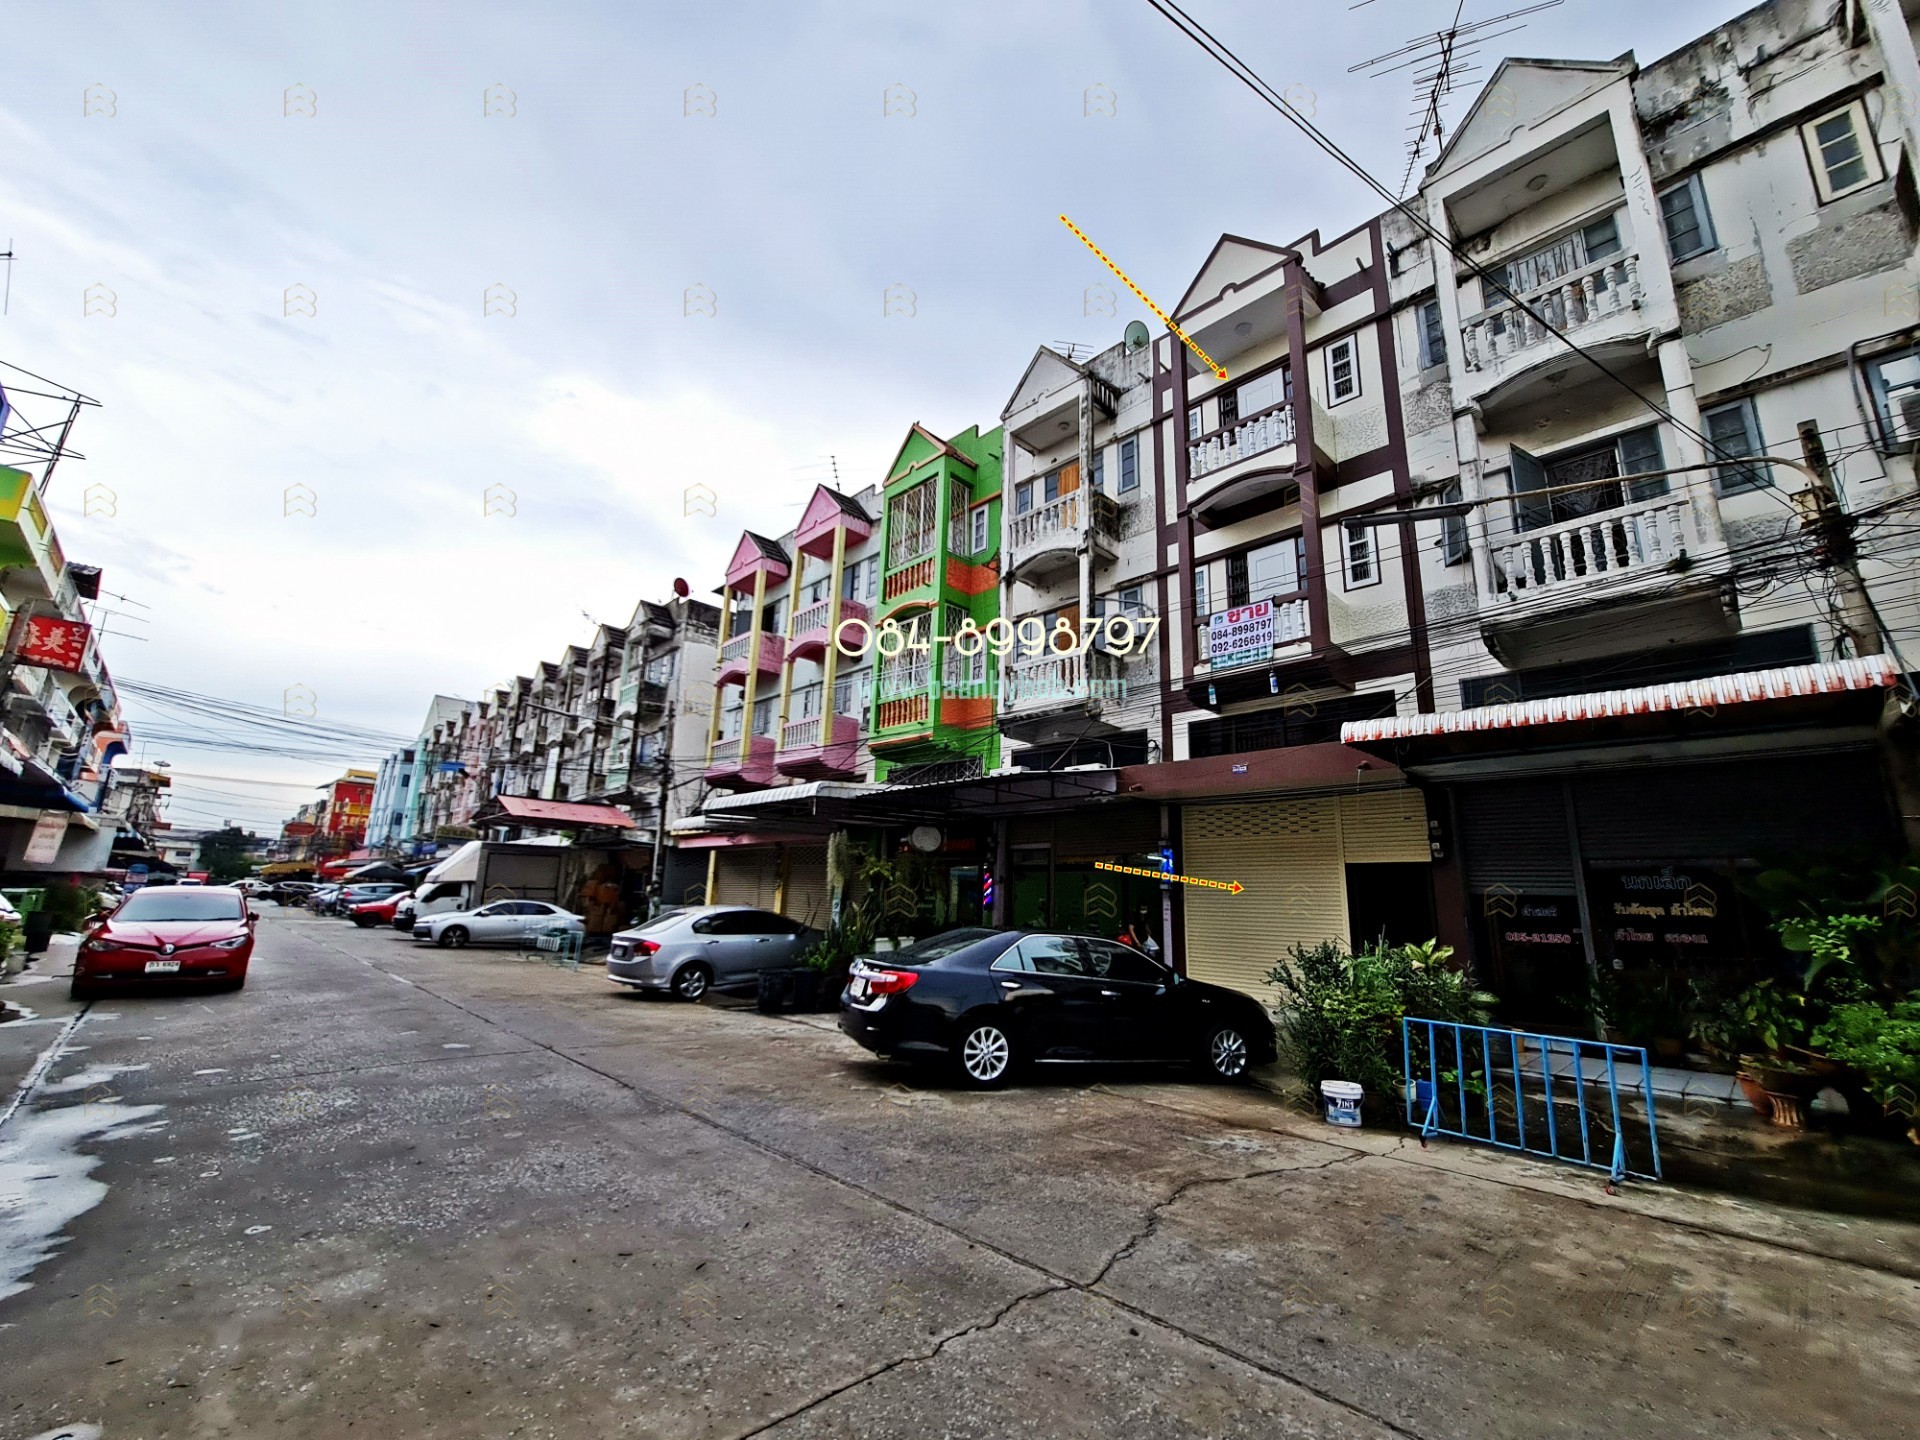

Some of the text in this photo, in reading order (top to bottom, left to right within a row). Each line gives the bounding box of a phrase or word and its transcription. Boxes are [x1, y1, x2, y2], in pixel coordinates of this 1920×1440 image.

[1227, 602, 1269, 624] ขาย
[1211, 618, 1272, 641] 084-8998797
[1211, 631, 1272, 654] 092-6266919
